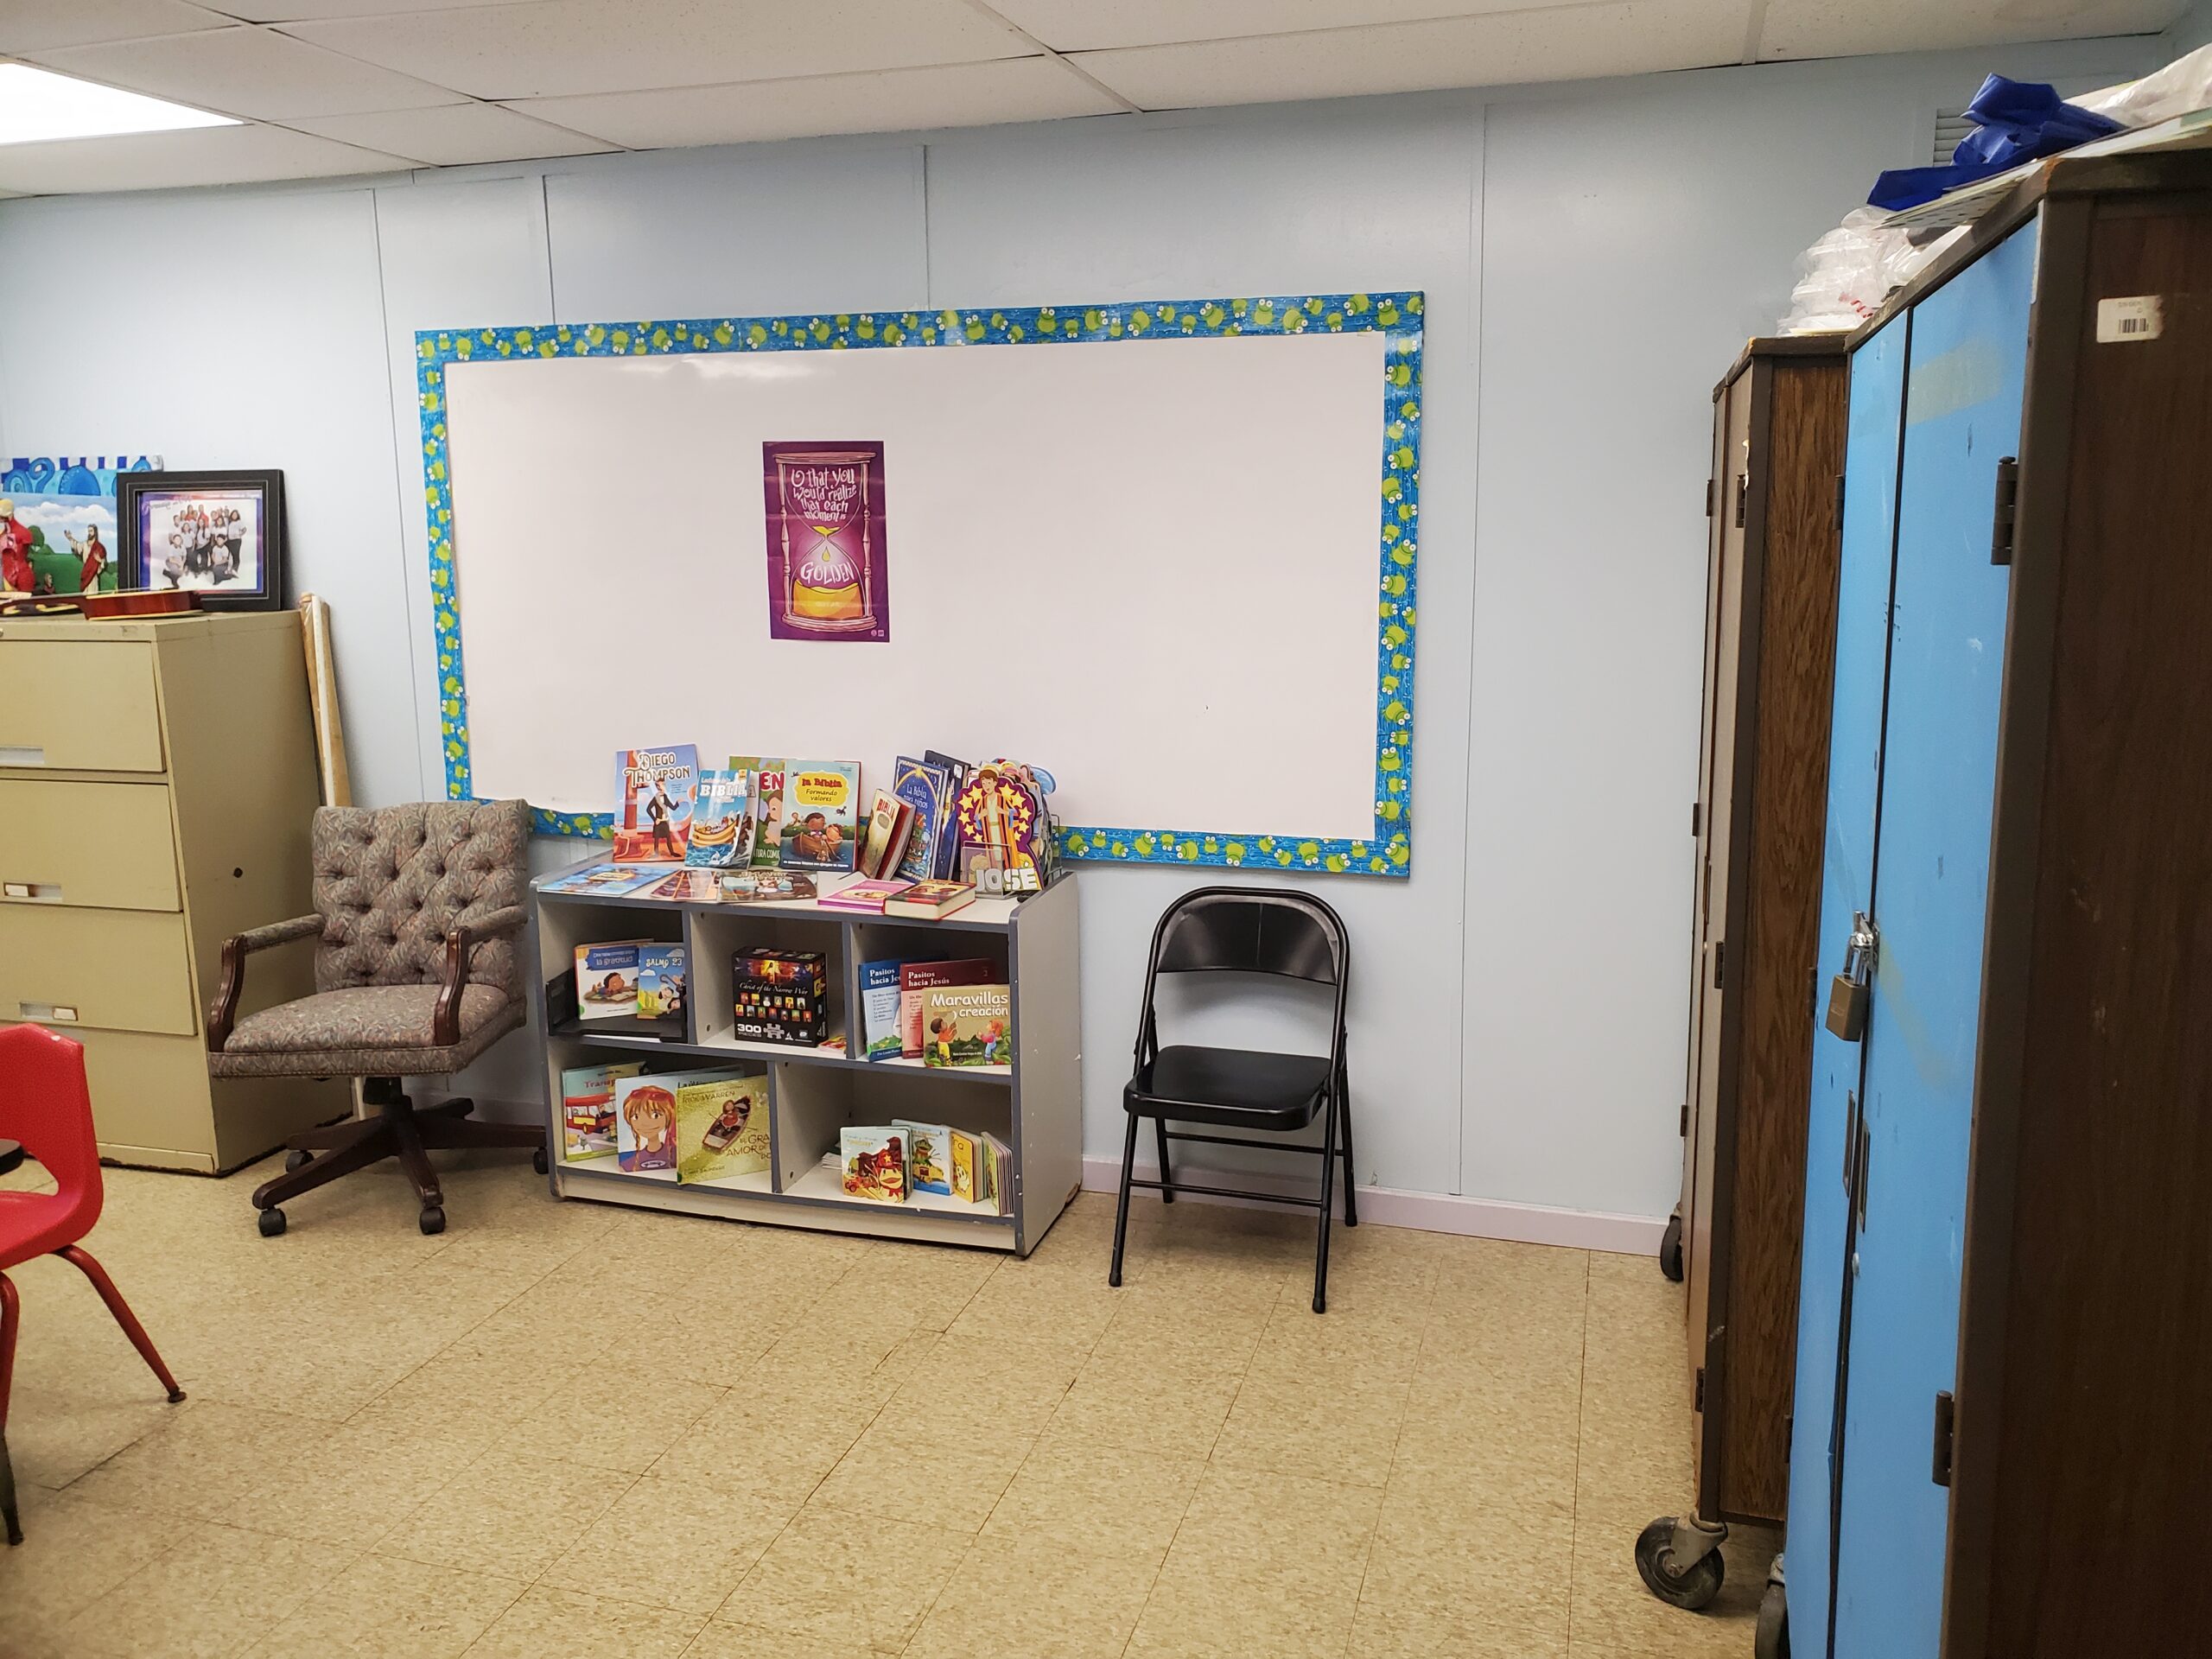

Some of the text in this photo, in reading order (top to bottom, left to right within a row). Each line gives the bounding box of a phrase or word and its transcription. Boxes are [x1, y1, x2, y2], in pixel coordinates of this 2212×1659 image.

[791, 467, 855, 489] O that you
[793, 485, 857, 501] would realize
[800, 497, 849, 512] that each
[804, 510, 840, 522] moment
[800, 562, 855, 585] GOLDEN
[639, 753, 676, 772] DIEGO
[623, 766, 690, 787] THOMPSON
[700, 784, 747, 796] BIBLIA
[805, 788, 838, 797] Formando
[913, 785, 927, 798] Biblia
[914, 798, 929, 810] niños
[645, 957, 683, 968] SALMO 23
[869, 968, 895, 977] Pasitos
[739, 979, 755, 990] Christ
[756, 981, 766, 994] of
[763, 983, 772, 992] the
[772, 985, 793, 994] Narrow
[870, 976, 889, 985] hacia
[908, 977, 950, 987] hacia Jesús
[931, 991, 1008, 1007] Maravillas
[958, 1004, 1008, 1017] creación
[737, 1023, 762, 1033] 300
[702, 1090, 735, 1101] WARREN
[727, 1145, 760, 1157] AMOR
